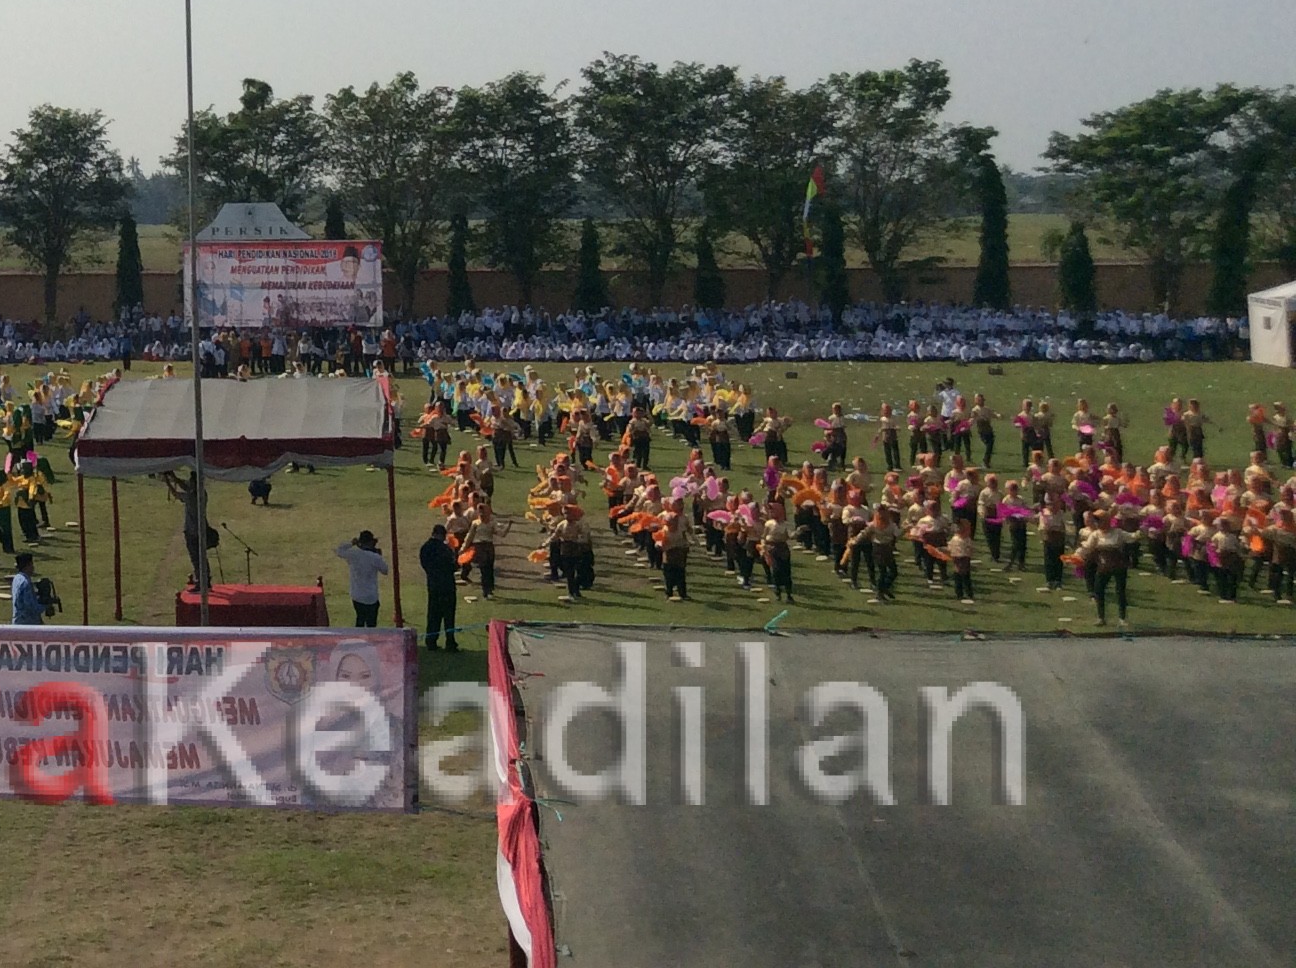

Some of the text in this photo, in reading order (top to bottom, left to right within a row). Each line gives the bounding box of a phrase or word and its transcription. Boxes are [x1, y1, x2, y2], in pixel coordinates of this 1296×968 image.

[211, 226, 289, 236] PERSIK
[218, 250, 235, 259] HARI
[237, 249, 281, 259] PENDIDIKAN
[283, 249, 319, 259] NASIONAL
[230, 265, 279, 275] MENGUATKAN
